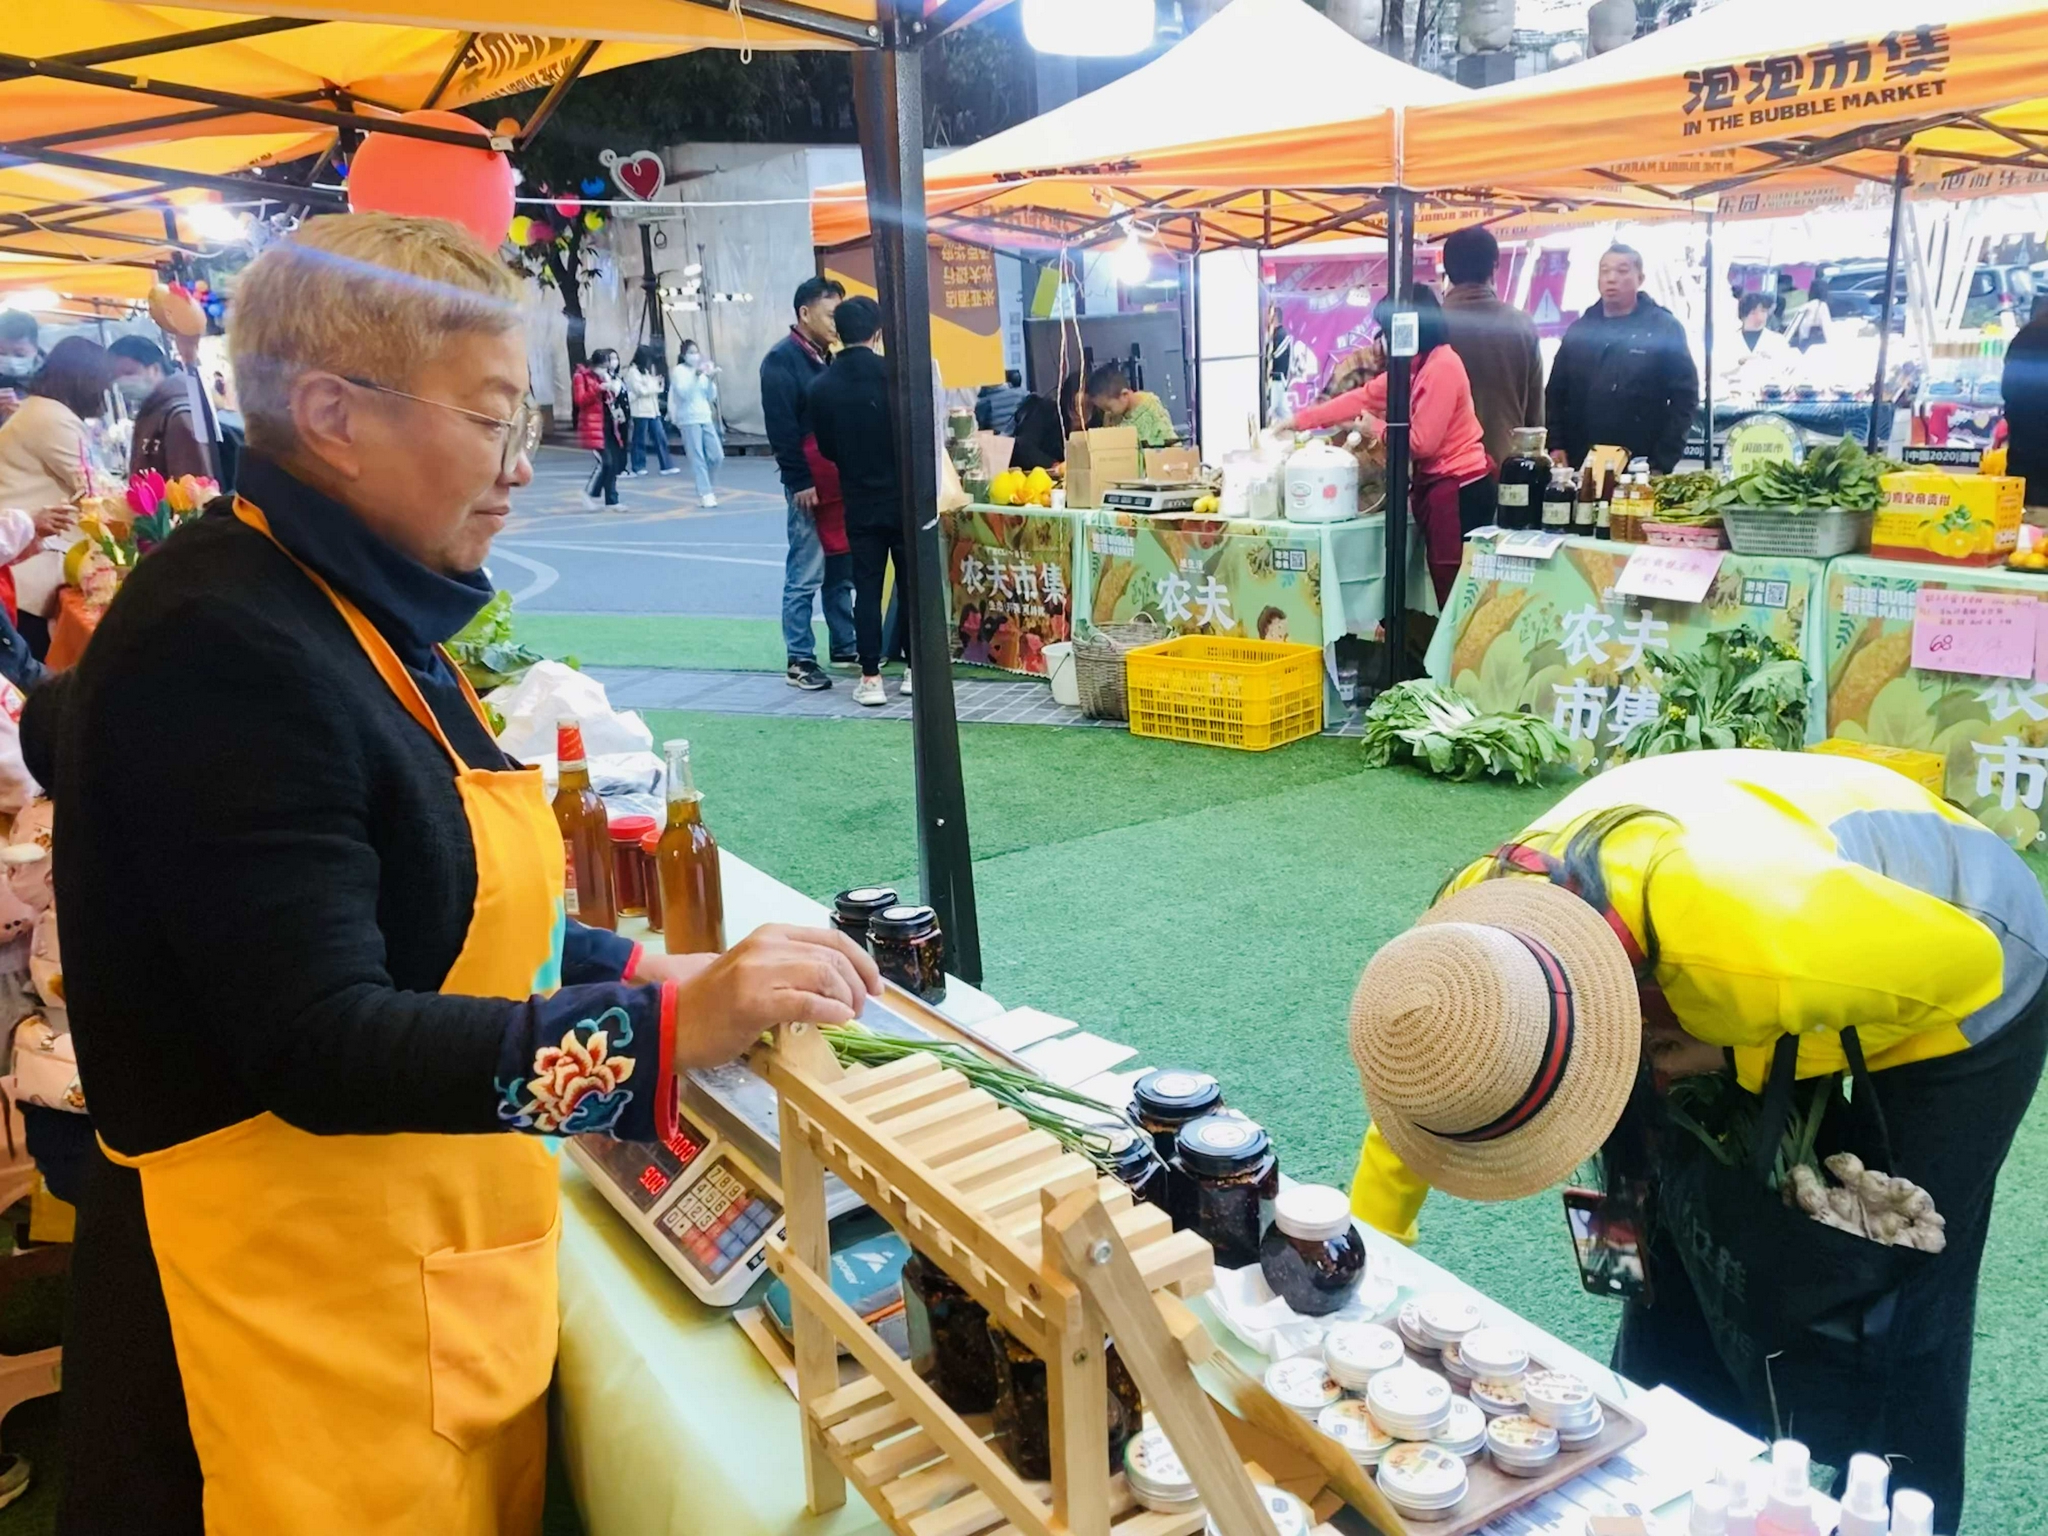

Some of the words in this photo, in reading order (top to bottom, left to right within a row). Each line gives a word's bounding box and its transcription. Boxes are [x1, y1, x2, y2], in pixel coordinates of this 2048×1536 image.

[1682, 23, 1950, 115] 泡泡市集
[1683, 120, 1702, 137] IN
[1707, 112, 1745, 132] THE
[1750, 98, 1837, 125] BUBBLE
[1842, 79, 1947, 111] MARKET
[961, 554, 1068, 605] 农夫市集
[1156, 571, 1237, 631] 农夫
[1496, 569, 1536, 584] MARKET
[1556, 603, 1669, 678] 农夫
[1929, 635, 1953, 652] 68
[1552, 677, 1662, 748] 市集
